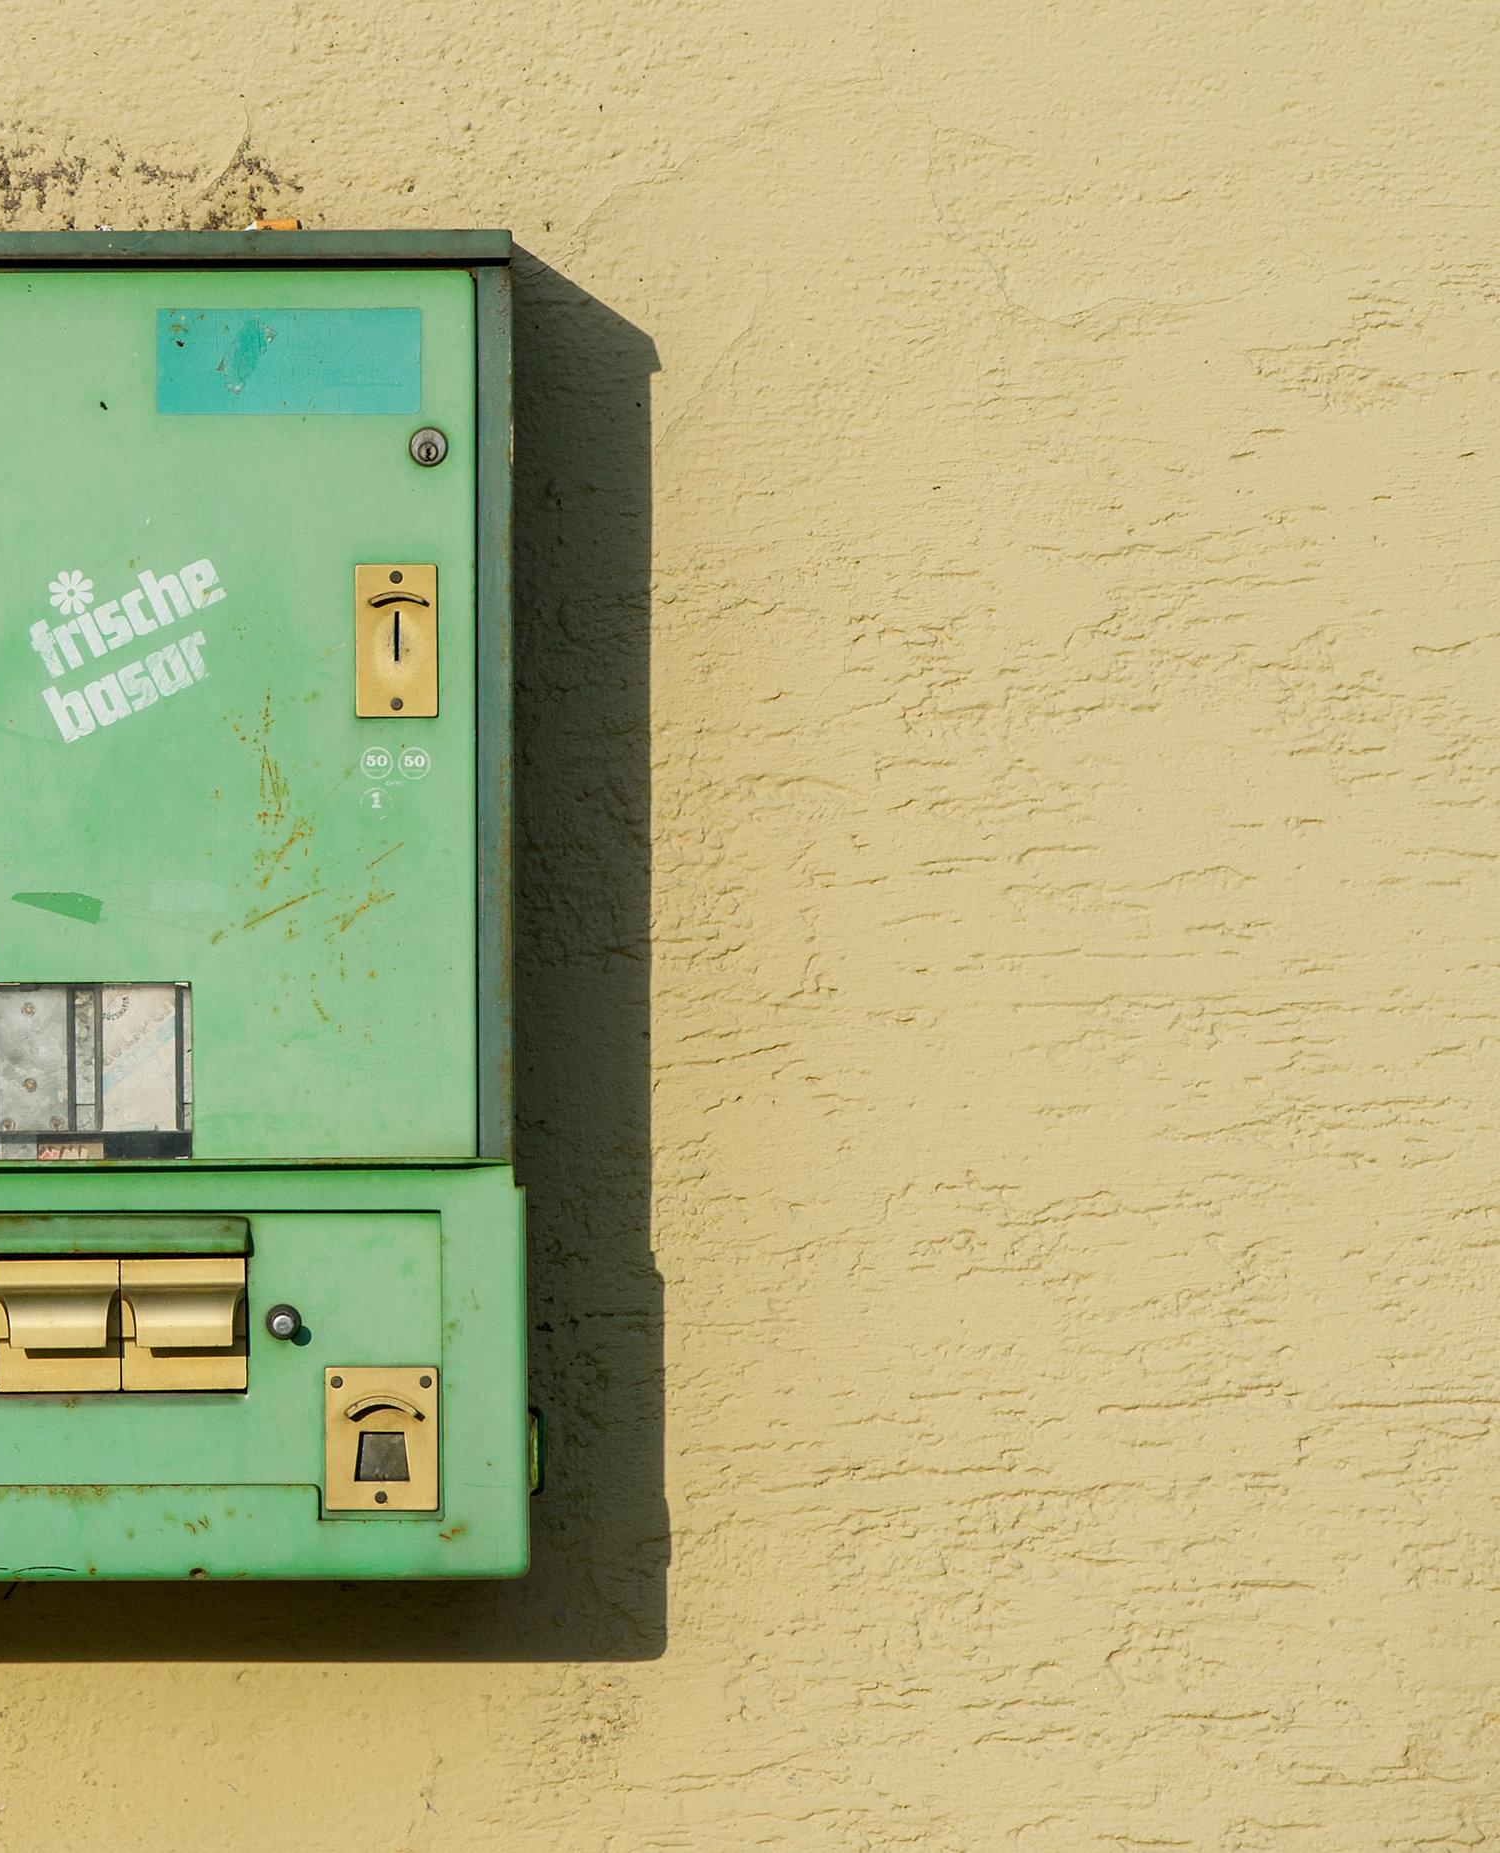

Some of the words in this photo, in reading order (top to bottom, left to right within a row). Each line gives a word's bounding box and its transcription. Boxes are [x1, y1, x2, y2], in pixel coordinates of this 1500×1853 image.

[29, 558, 227, 679] frische
[41, 630, 209, 744] basar
[366, 755, 388, 767] 50
[404, 755, 426, 768] 50
[371, 791, 382, 809] 1
